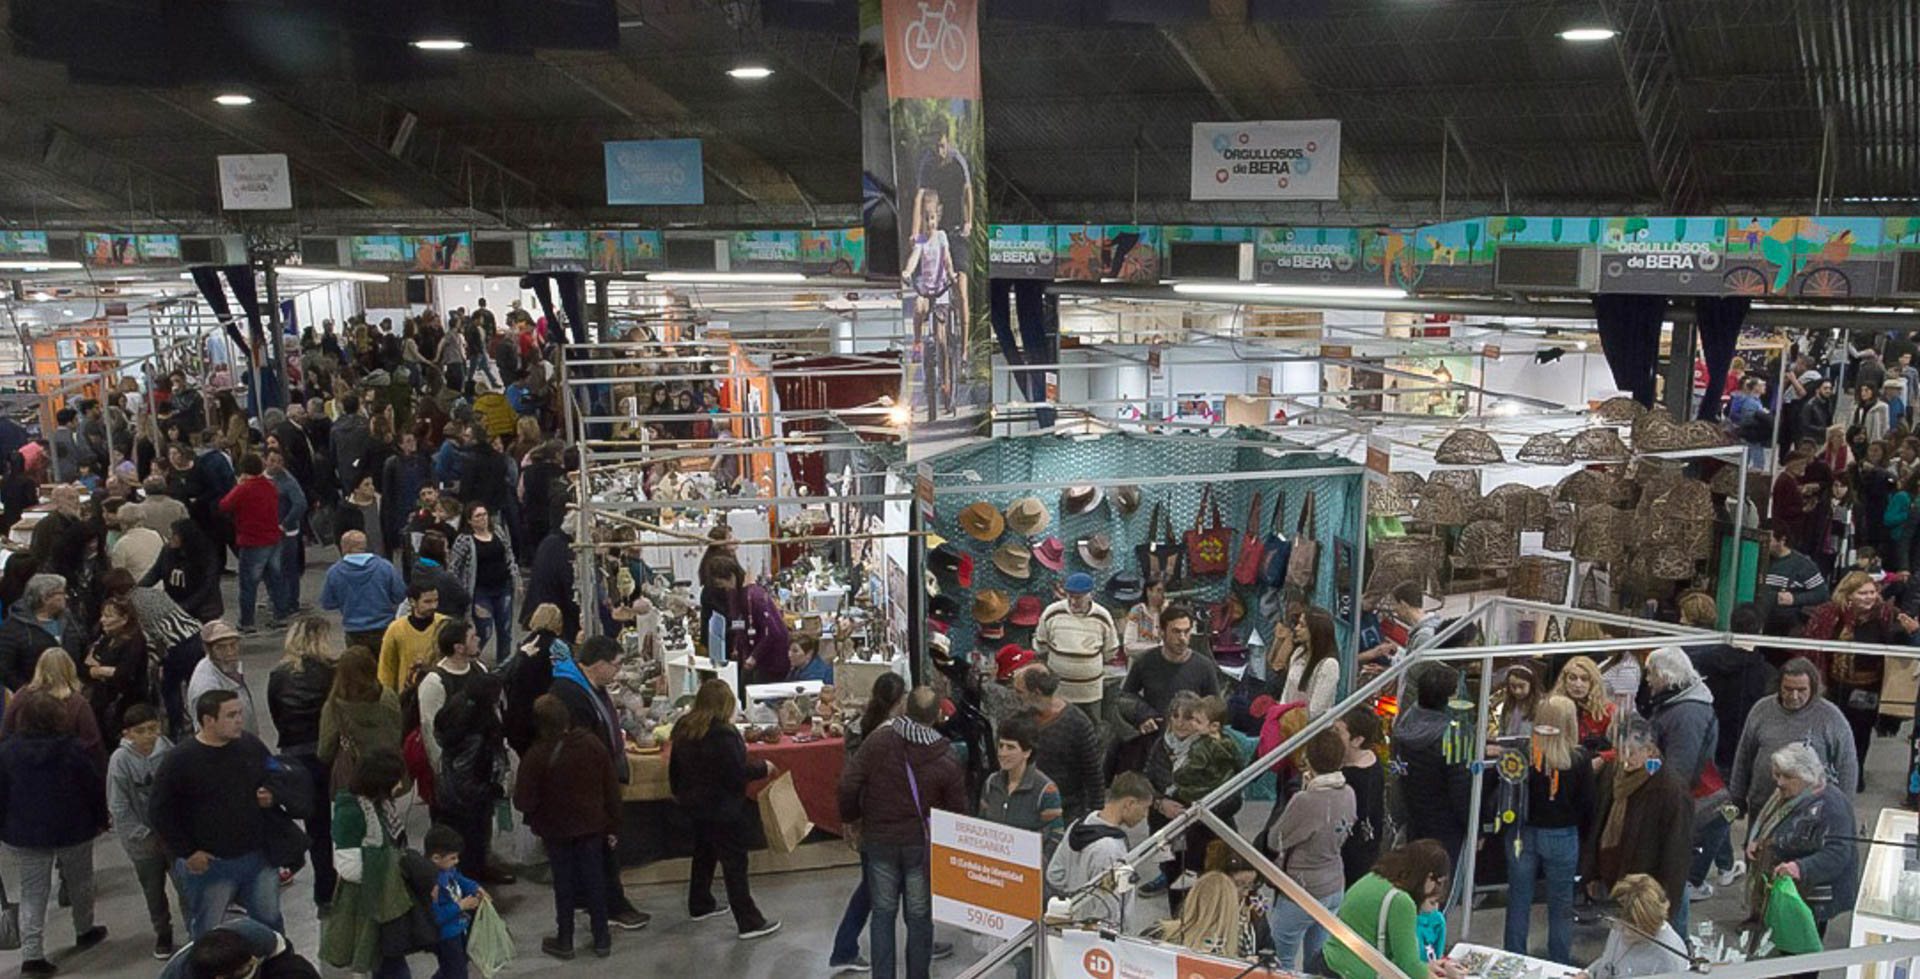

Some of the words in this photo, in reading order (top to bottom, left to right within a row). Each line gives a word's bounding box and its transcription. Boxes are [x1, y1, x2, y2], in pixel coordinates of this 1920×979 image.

[1223, 148, 1304, 160] ORGULLOSOS
[1232, 164, 1248, 174] de
[1248, 161, 1290, 174] BERA
[1268, 243, 1345, 255] ORGULLOSOS
[1618, 242, 1710, 254] ORGULLOSOS
[1002, 251, 1036, 263] BERA
[1277, 256, 1291, 267] de
[1292, 254, 1332, 269] BERA
[1627, 256, 1645, 268] de
[1646, 254, 1694, 269] BERA
[967, 908, 1004, 930] 59/60
